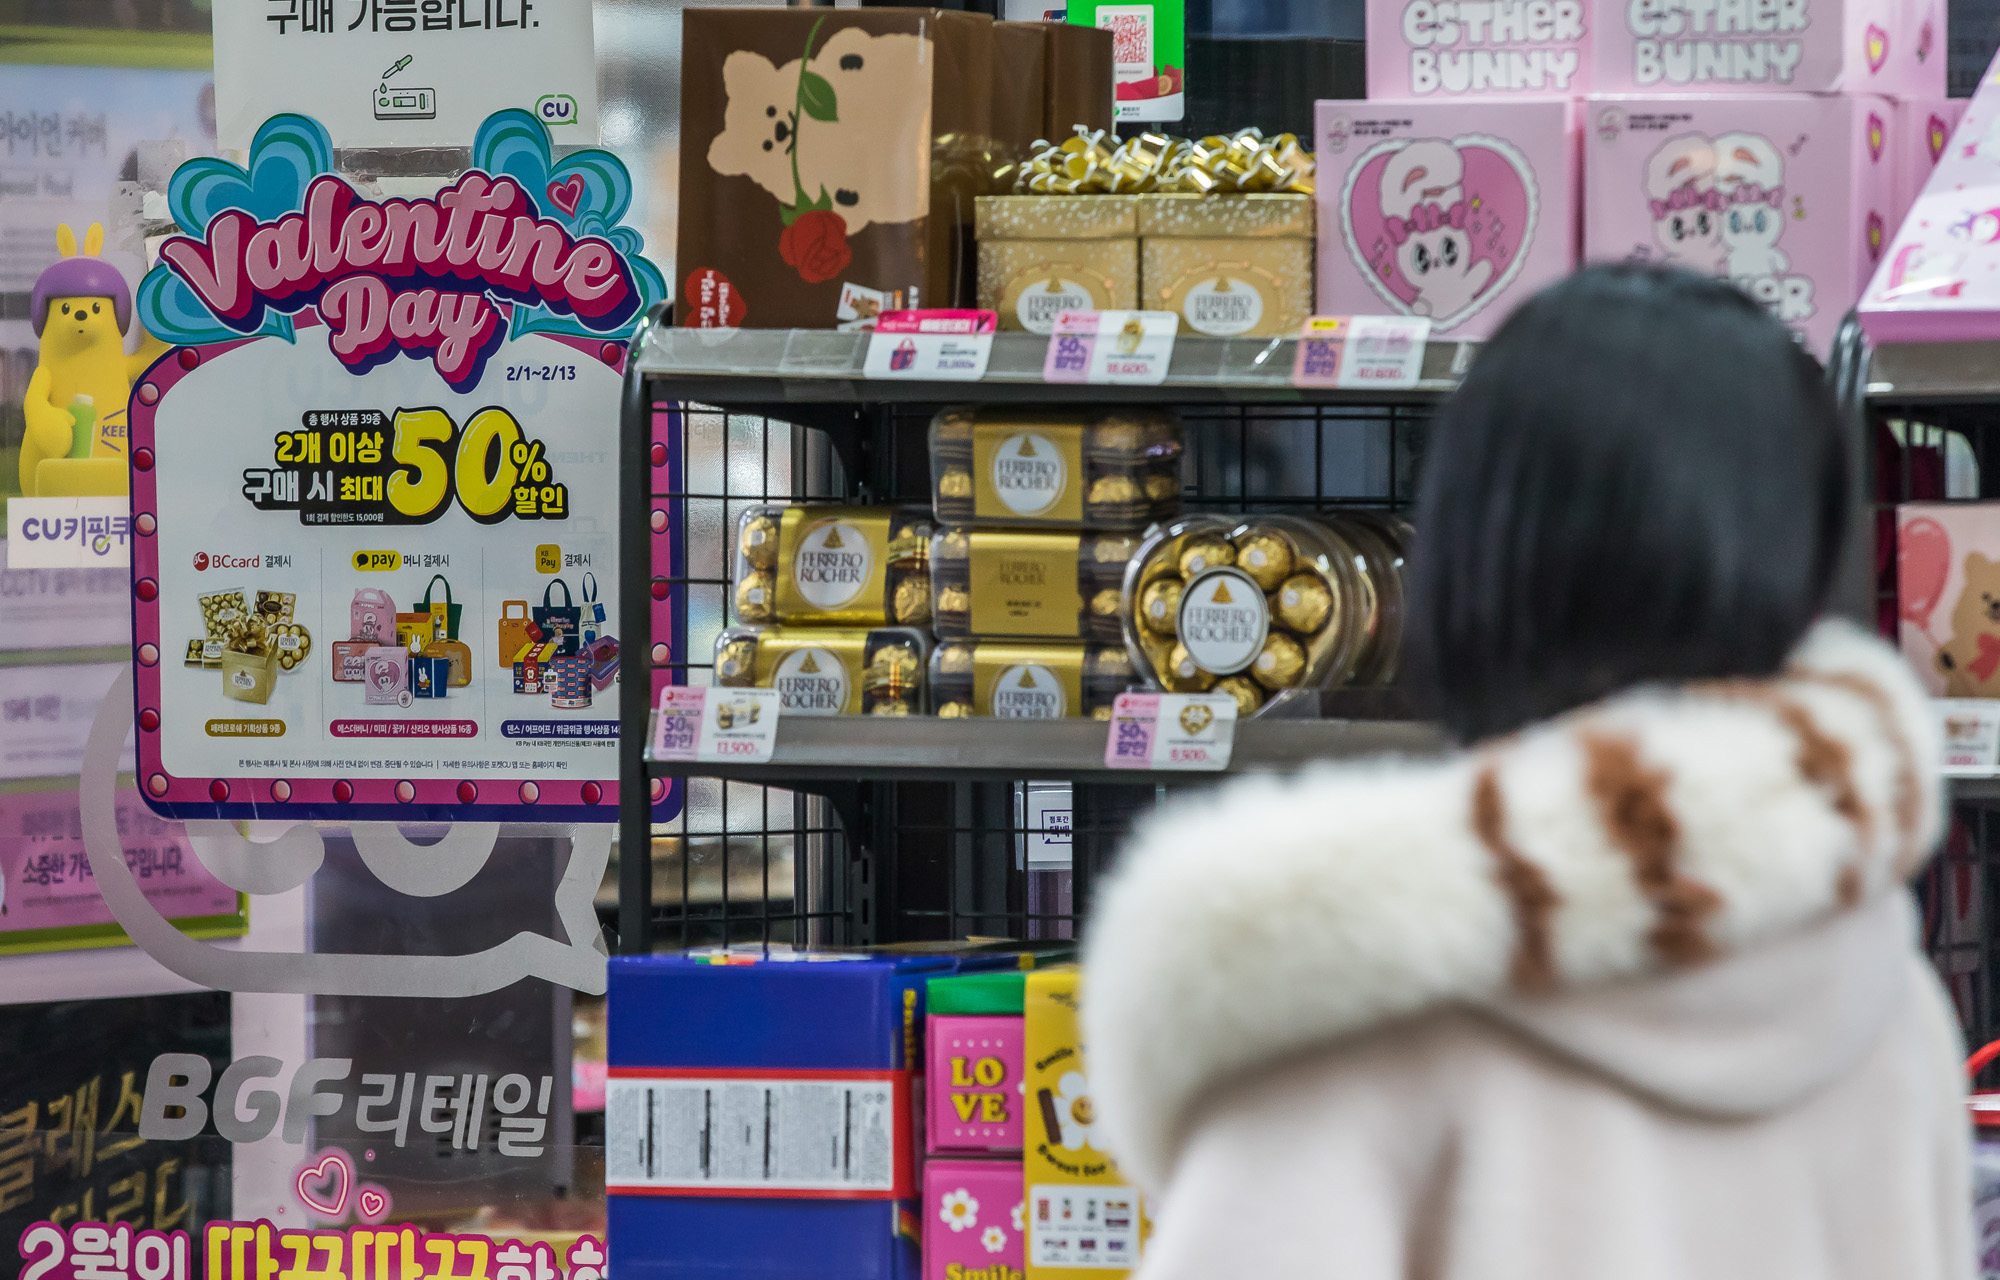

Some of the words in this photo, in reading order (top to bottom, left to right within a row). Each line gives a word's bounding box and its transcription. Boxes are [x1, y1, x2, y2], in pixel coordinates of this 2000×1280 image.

[267, 0, 333, 34] 구매
[348, 0, 540, 32] 가능합니다.
[1637, 42, 1800, 83] BUNNY
[1412, 50, 1578, 93] BUNNY
[542, 102, 570, 118] CU
[162, 172, 622, 314] Valentine
[322, 274, 490, 374] Day
[506, 366, 576, 381] 2/1~2/13
[308, 413, 318, 426] 총
[320, 413, 339, 426] 행사
[341, 413, 359, 426] 상품
[360, 413, 381, 426] 39종
[102, 425, 128, 438] KEE
[277, 432, 321, 464] 2개
[329, 432, 384, 463] 이상
[999, 460, 1057, 476] FERRERO
[245, 471, 299, 502] 구매
[307, 471, 334, 501] 시
[340, 476, 383, 501] 최대
[999, 475, 1056, 490] ROCHER
[514, 486, 564, 514] 할인
[305, 513, 315, 523] 1회
[316, 513, 329, 523] 결제
[330, 513, 355, 523] 할인한도
[356, 513, 384, 523] 15,000원
[212, 554, 260, 568] BCcard
[265, 555, 292, 568] 결제시
[371, 553, 396, 568] pay
[403, 554, 421, 567] 머니
[423, 554, 450, 568] 결제시
[541, 558, 556, 568] Pay
[564, 553, 591, 567] 결제시
[802, 552, 864, 568] FERRERO
[800, 568, 861, 584] ROCHER
[1188, 607, 1257, 625] FERRERO
[1188, 626, 1254, 642] ROCHER
[779, 678, 840, 693] FERRERO
[781, 693, 838, 709] ROCHER
[999, 692, 1057, 706] FERRERO
[243, 724, 268, 734] 기획상품
[269, 724, 281, 734] 9종
[337, 724, 369, 734] 에스더버니
[374, 724, 387, 734] 미피
[411, 725, 431, 734] 산리오
[432, 725, 457, 735] 행사상품
[458, 725, 472, 735] 16종
[525, 725, 551, 735] 어프어프
[584, 725, 610, 735] 행사상품
[22, 853, 66, 886] 소중한
[950, 1056, 1004, 1087] LO
[950, 1092, 1007, 1123] VE
